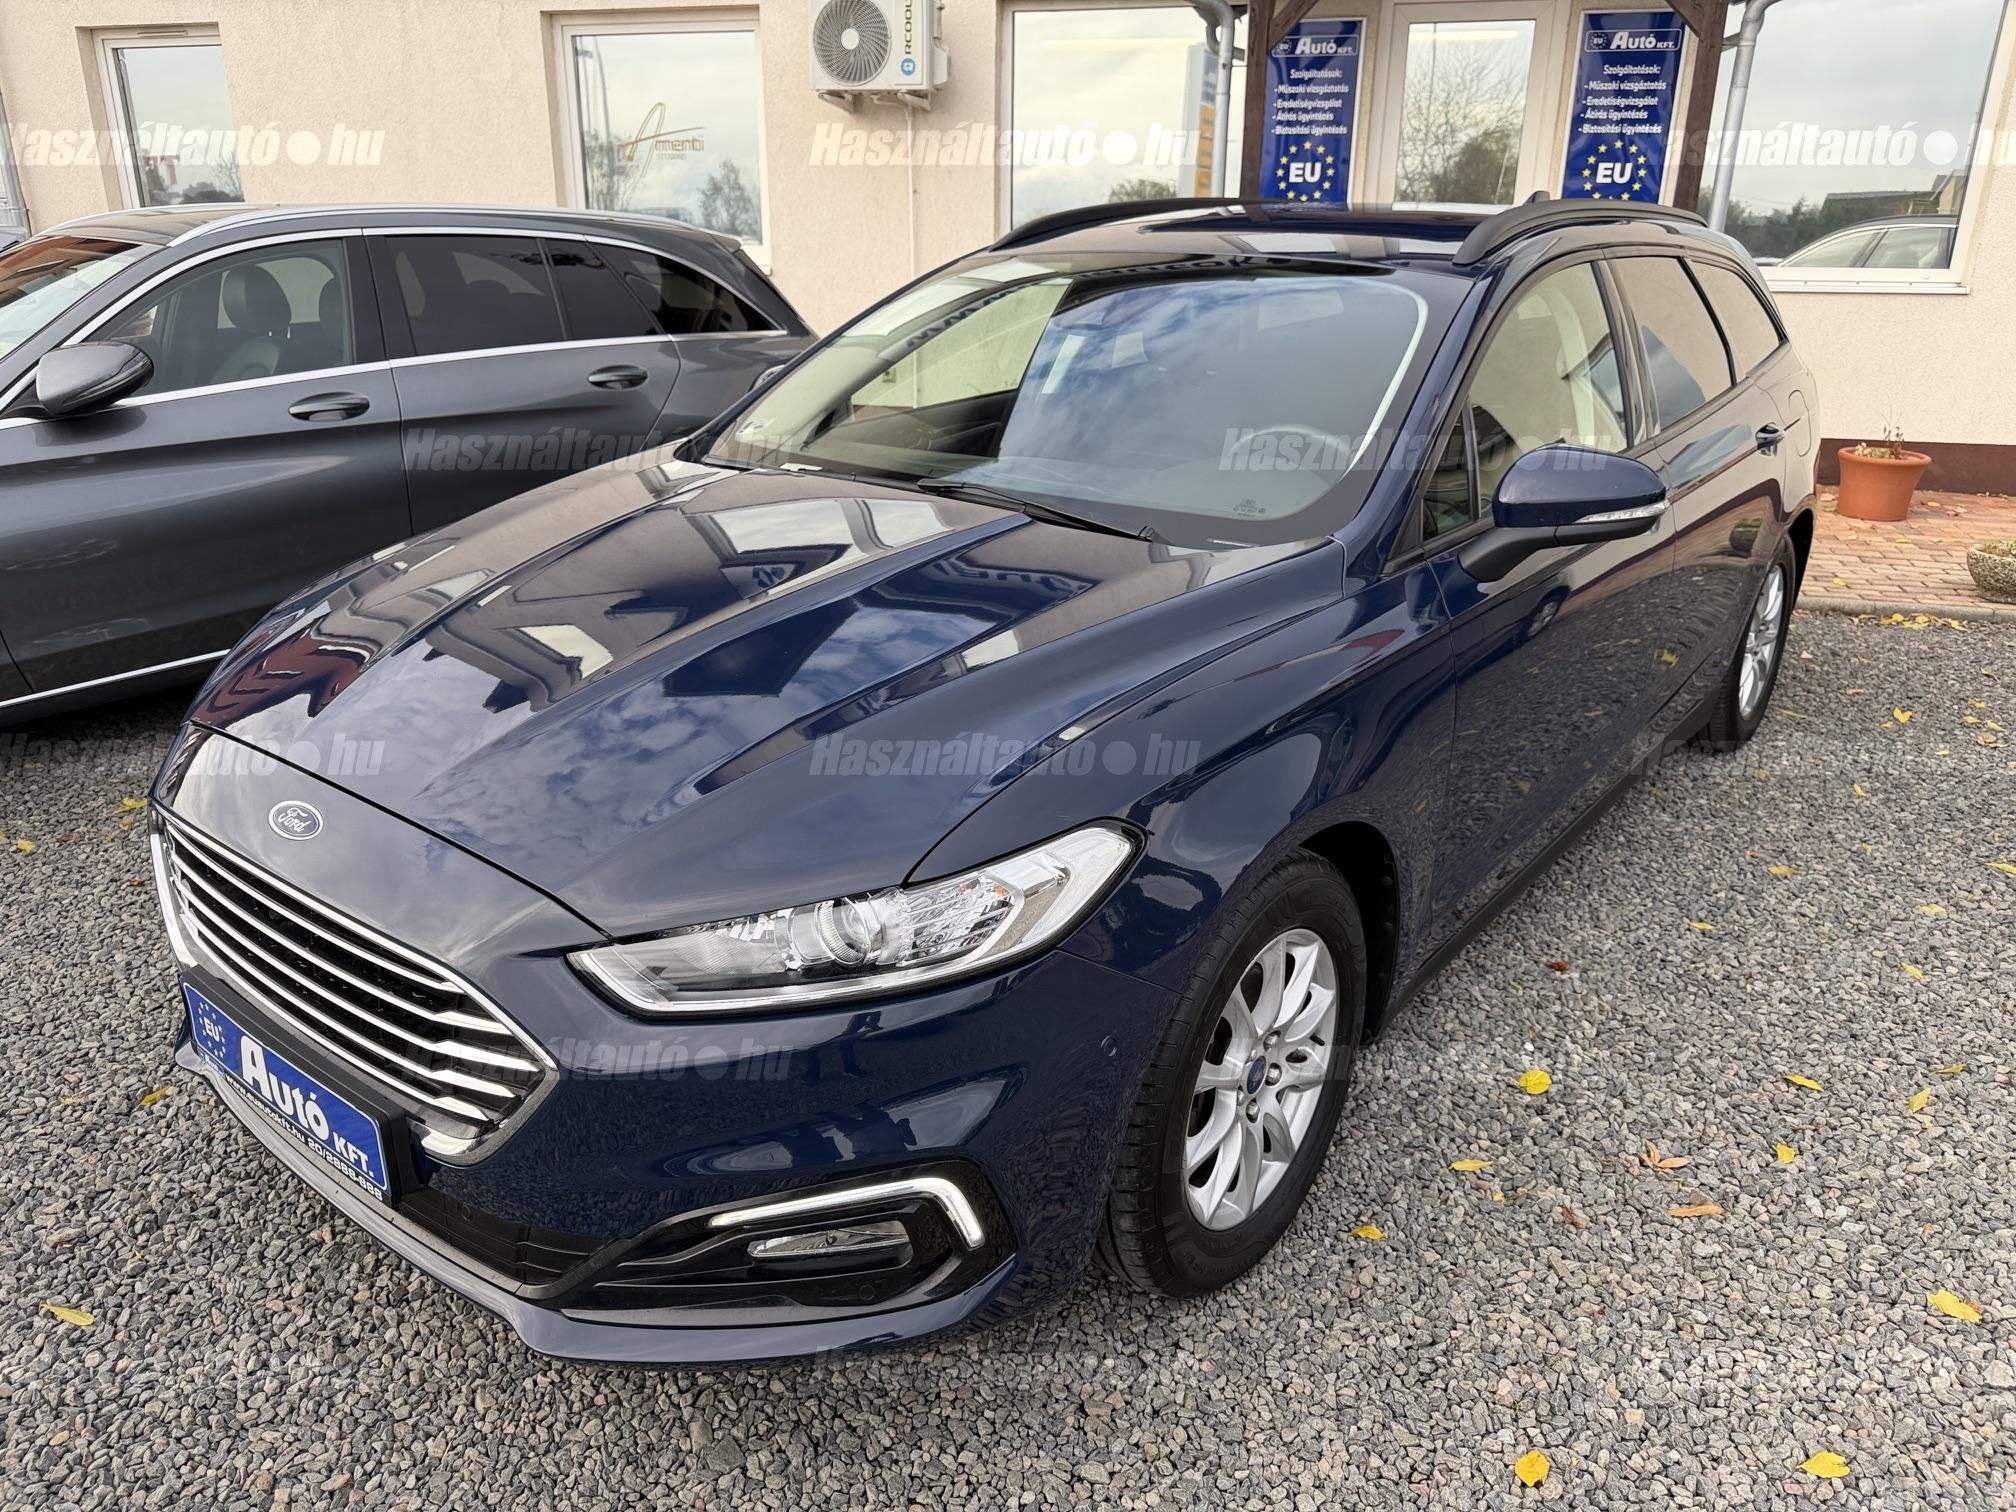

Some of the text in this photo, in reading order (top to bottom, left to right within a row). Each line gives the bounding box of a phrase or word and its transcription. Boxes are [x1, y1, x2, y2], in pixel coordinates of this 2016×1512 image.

[1294, 38, 1337, 54] Autó
[1610, 32, 1657, 49] Autó
[1289, 162, 1322, 183] EU
[1596, 162, 1632, 184] EU
[277, 806, 312, 832] Ford
[204, 1016, 222, 1043] EU
[240, 1035, 375, 1178] Autó KFT.
[307, 1138, 383, 1201] 20/2888-888
